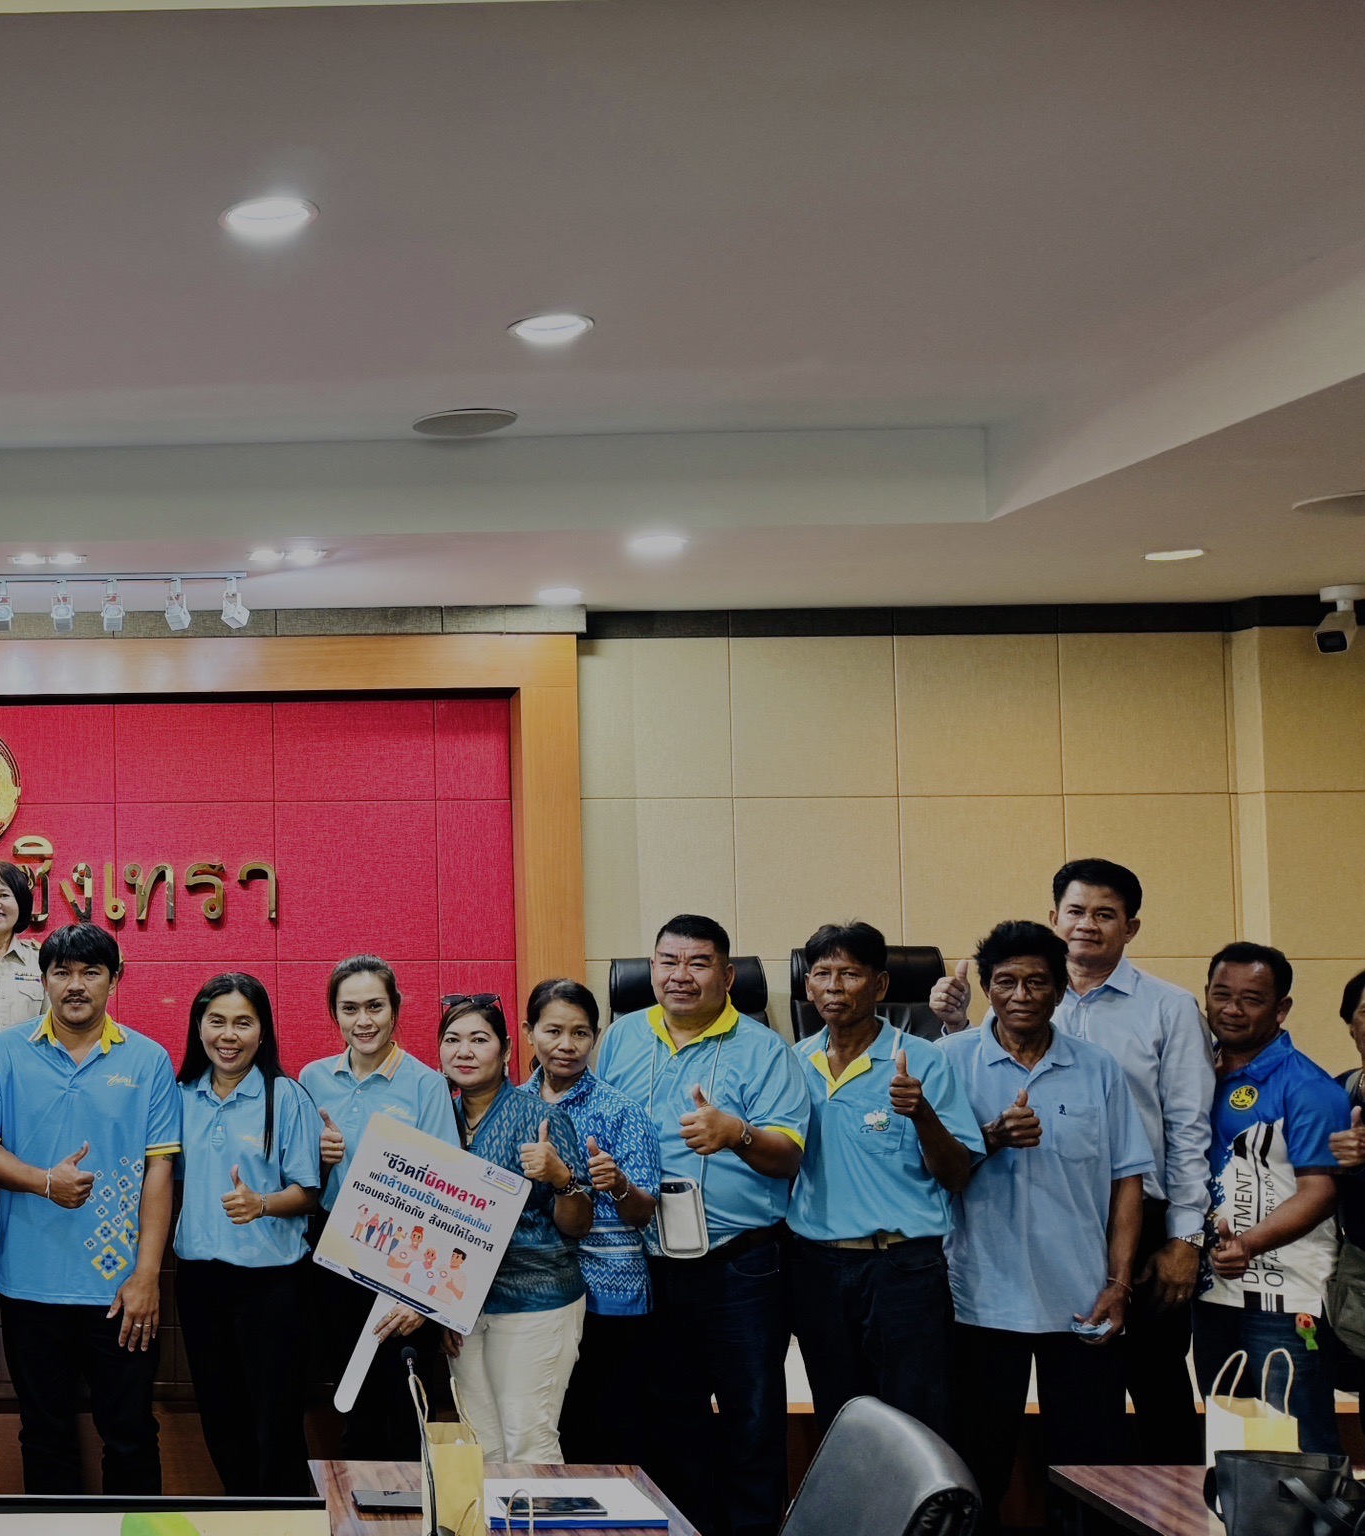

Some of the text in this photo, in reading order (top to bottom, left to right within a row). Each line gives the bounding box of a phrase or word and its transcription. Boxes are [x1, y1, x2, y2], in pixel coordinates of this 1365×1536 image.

[352, 1179, 494, 1253] ครอบครัวให้อภัย สังคมให้โอกาส
